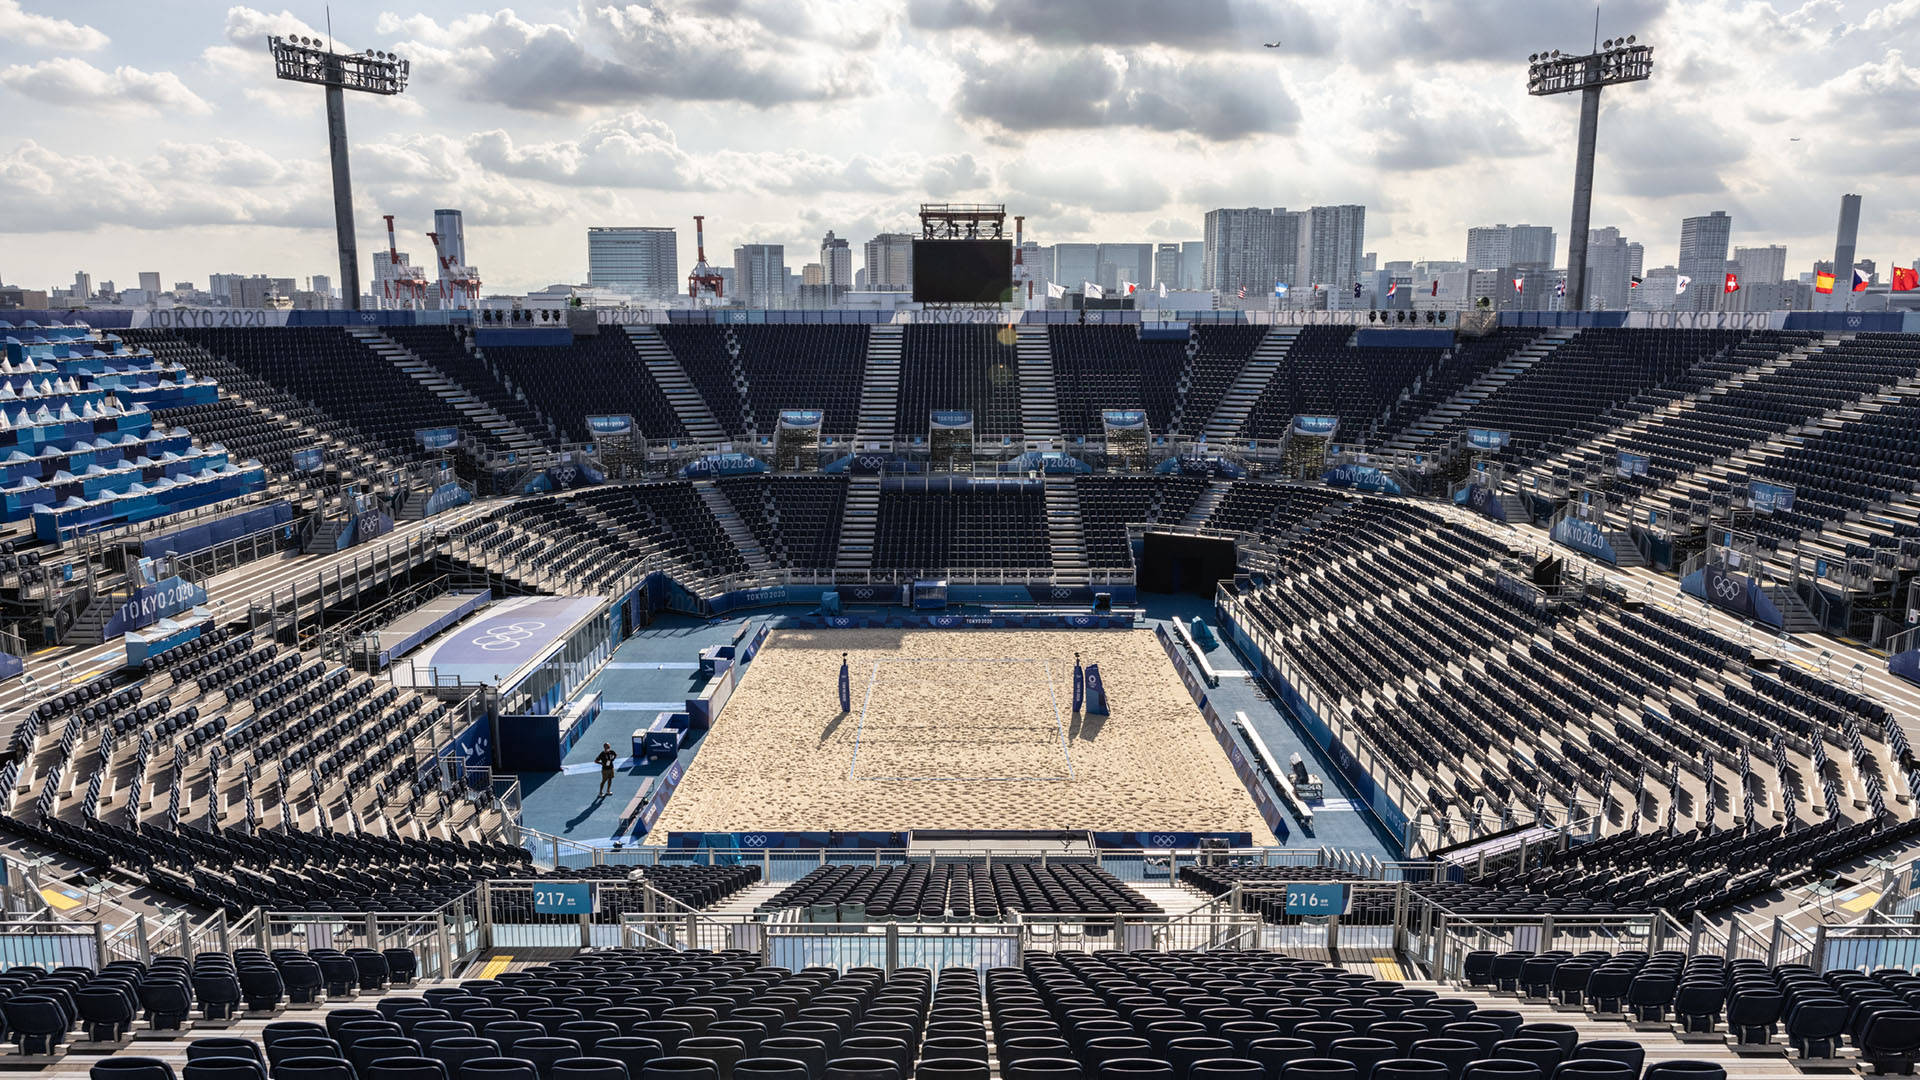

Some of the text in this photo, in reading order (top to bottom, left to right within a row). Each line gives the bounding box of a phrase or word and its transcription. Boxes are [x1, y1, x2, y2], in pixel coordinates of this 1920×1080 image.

[150, 309, 266, 328] TOKYO 2020
[611, 310, 650, 324] 2020
[912, 310, 1004, 324] TOKYO 2020
[1265, 311, 1362, 325] TOKYO 2020
[1649, 312, 1768, 330] TOKYO 2020
[694, 457, 755, 471] TOKYO 2020
[1051, 457, 1076, 468] 2020
[1335, 469, 1387, 486] TOKYO 2020
[1582, 529, 1604, 550] 2020
[121, 582, 194, 622] TOKYO 2020
[746, 590, 786, 601] TOKYO 2020
[536, 891, 565, 906] 217
[1288, 892, 1318, 907] 216
